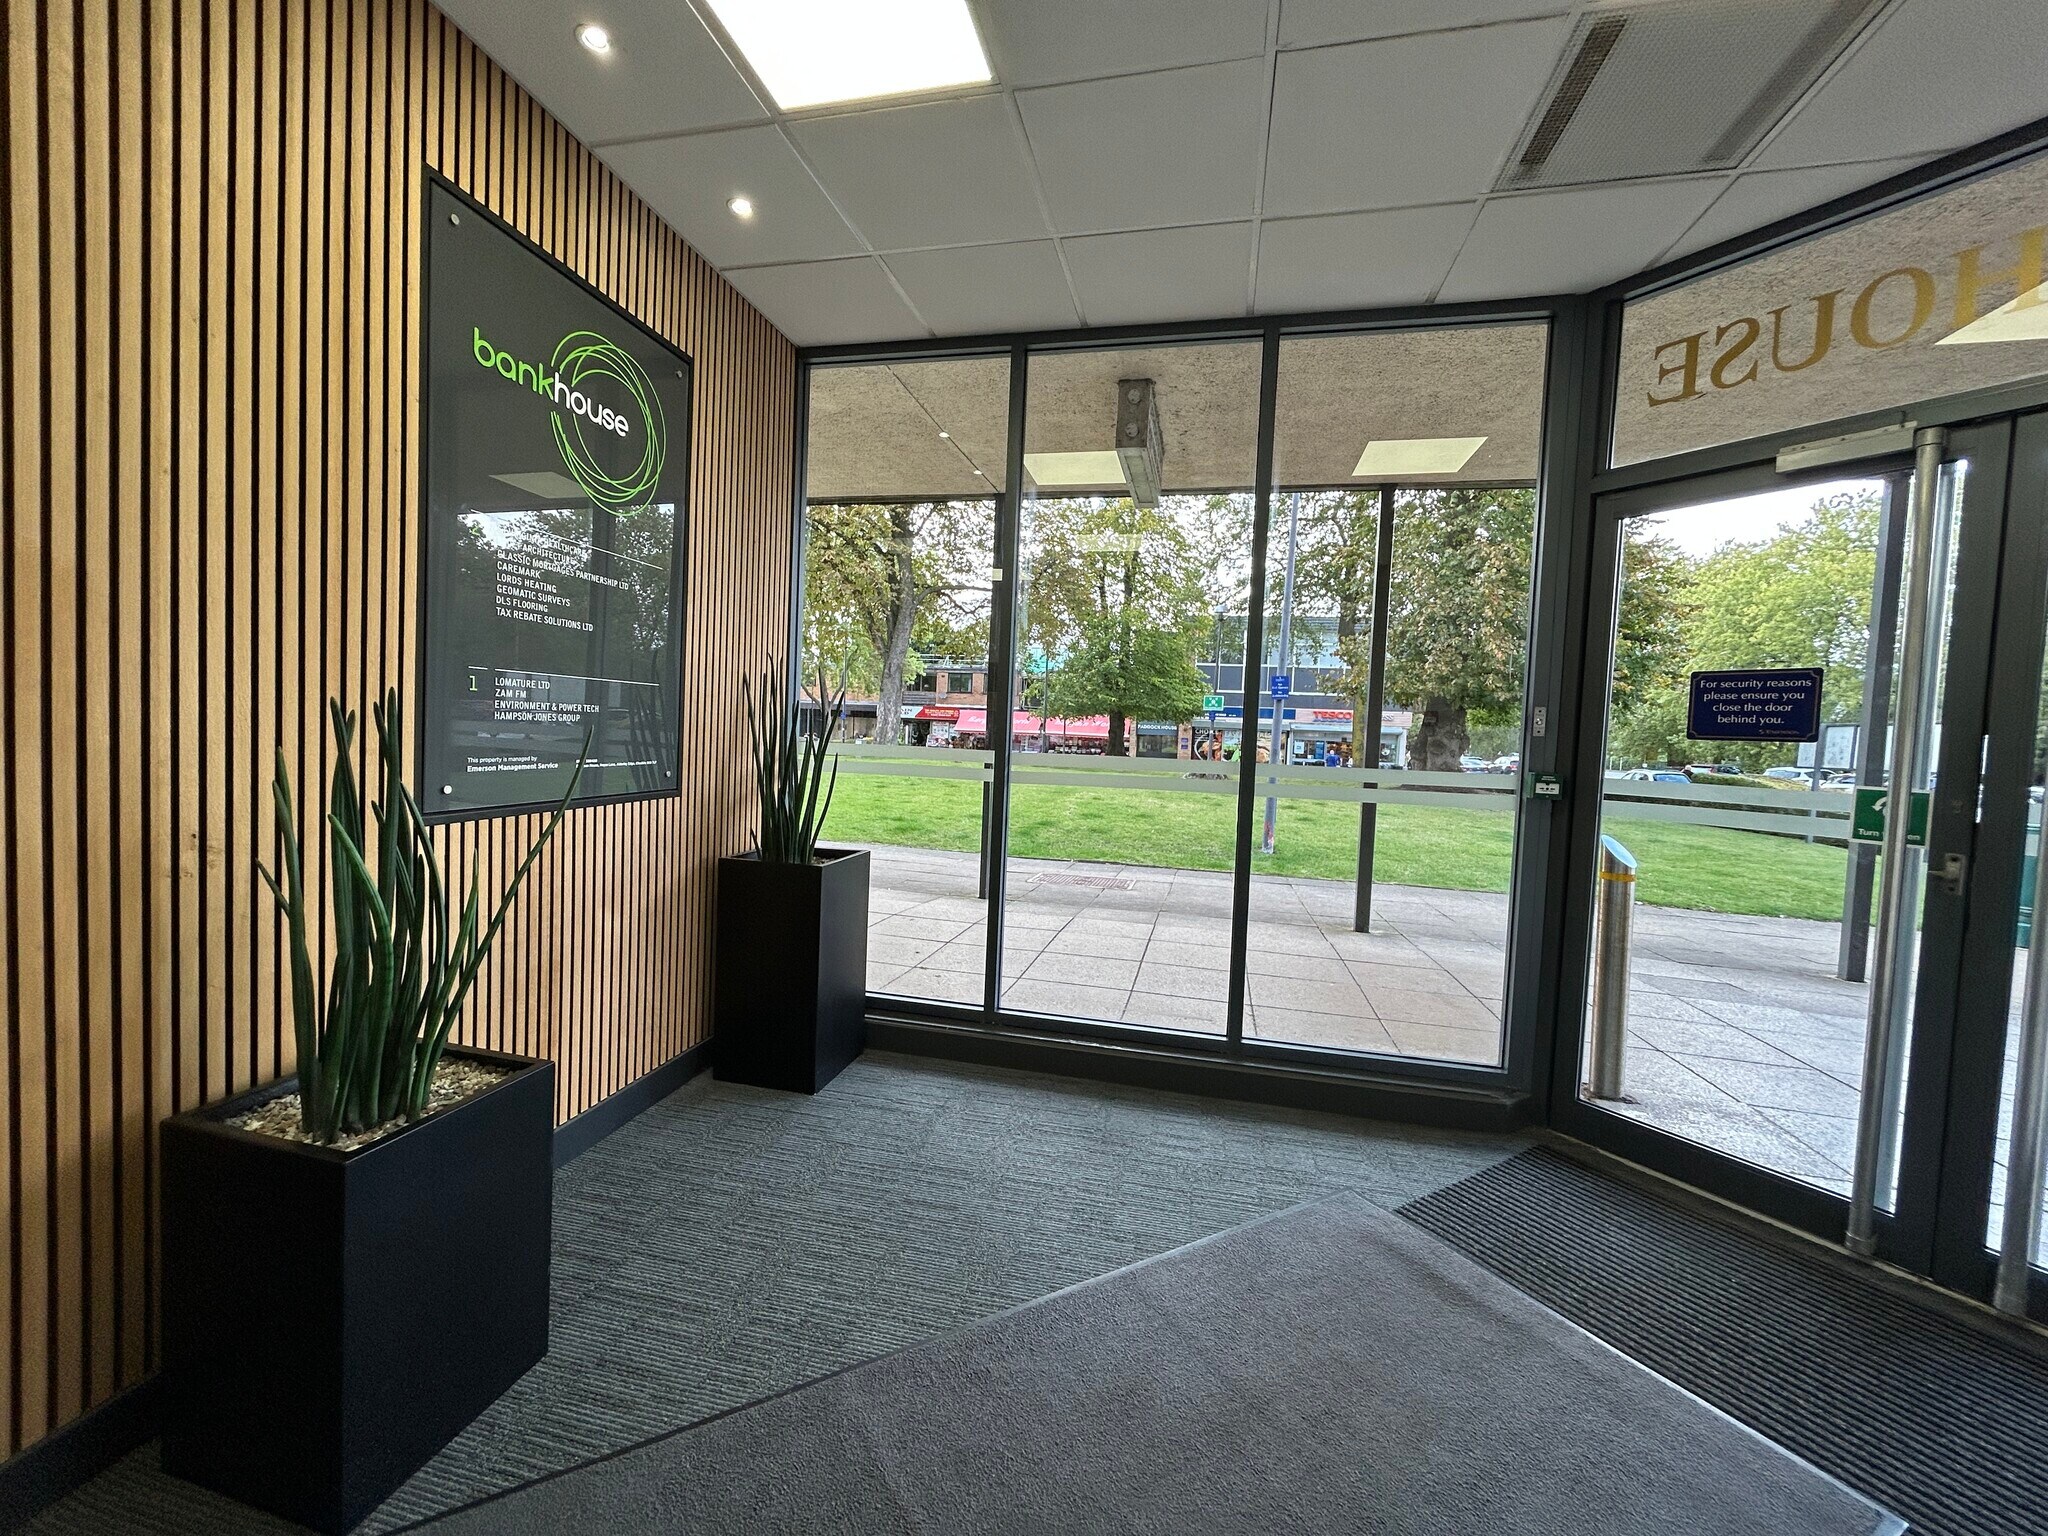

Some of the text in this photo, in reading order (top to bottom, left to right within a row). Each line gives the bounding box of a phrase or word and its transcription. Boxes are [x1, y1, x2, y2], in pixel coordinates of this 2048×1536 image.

[496, 561, 541, 579] CAREMARK
[496, 572, 557, 593] LORDS HEATING
[575, 570, 618, 587] PARTNERSHIP
[618, 581, 629, 590] LTD
[496, 584, 571, 607] GEOMATIC SURVEYS
[495, 595, 549, 613] DLS FLOORING
[495, 606, 594, 632] TAX REBATE SOLUTIONS LTD
[469, 675, 478, 691] 1
[495, 677, 551, 690] LOMATURE LTD
[1700, 679, 1812, 690] For security reasons
[494, 688, 527, 698] ZAM FM
[1703, 691, 1805, 702] please ensure you
[494, 700, 600, 713] ENVIRONMENT & POWER TECH
[1712, 702, 1793, 712] close the door
[557, 713, 581, 722] GROUP
[1312, 710, 1353, 720] TESCO
[1717, 714, 1784, 726] behind you.
[479, 756, 502, 764] property
[466, 765, 497, 773] Emerson
[497, 763, 537, 772] Management
[1857, 828, 1880, 837] Turn
